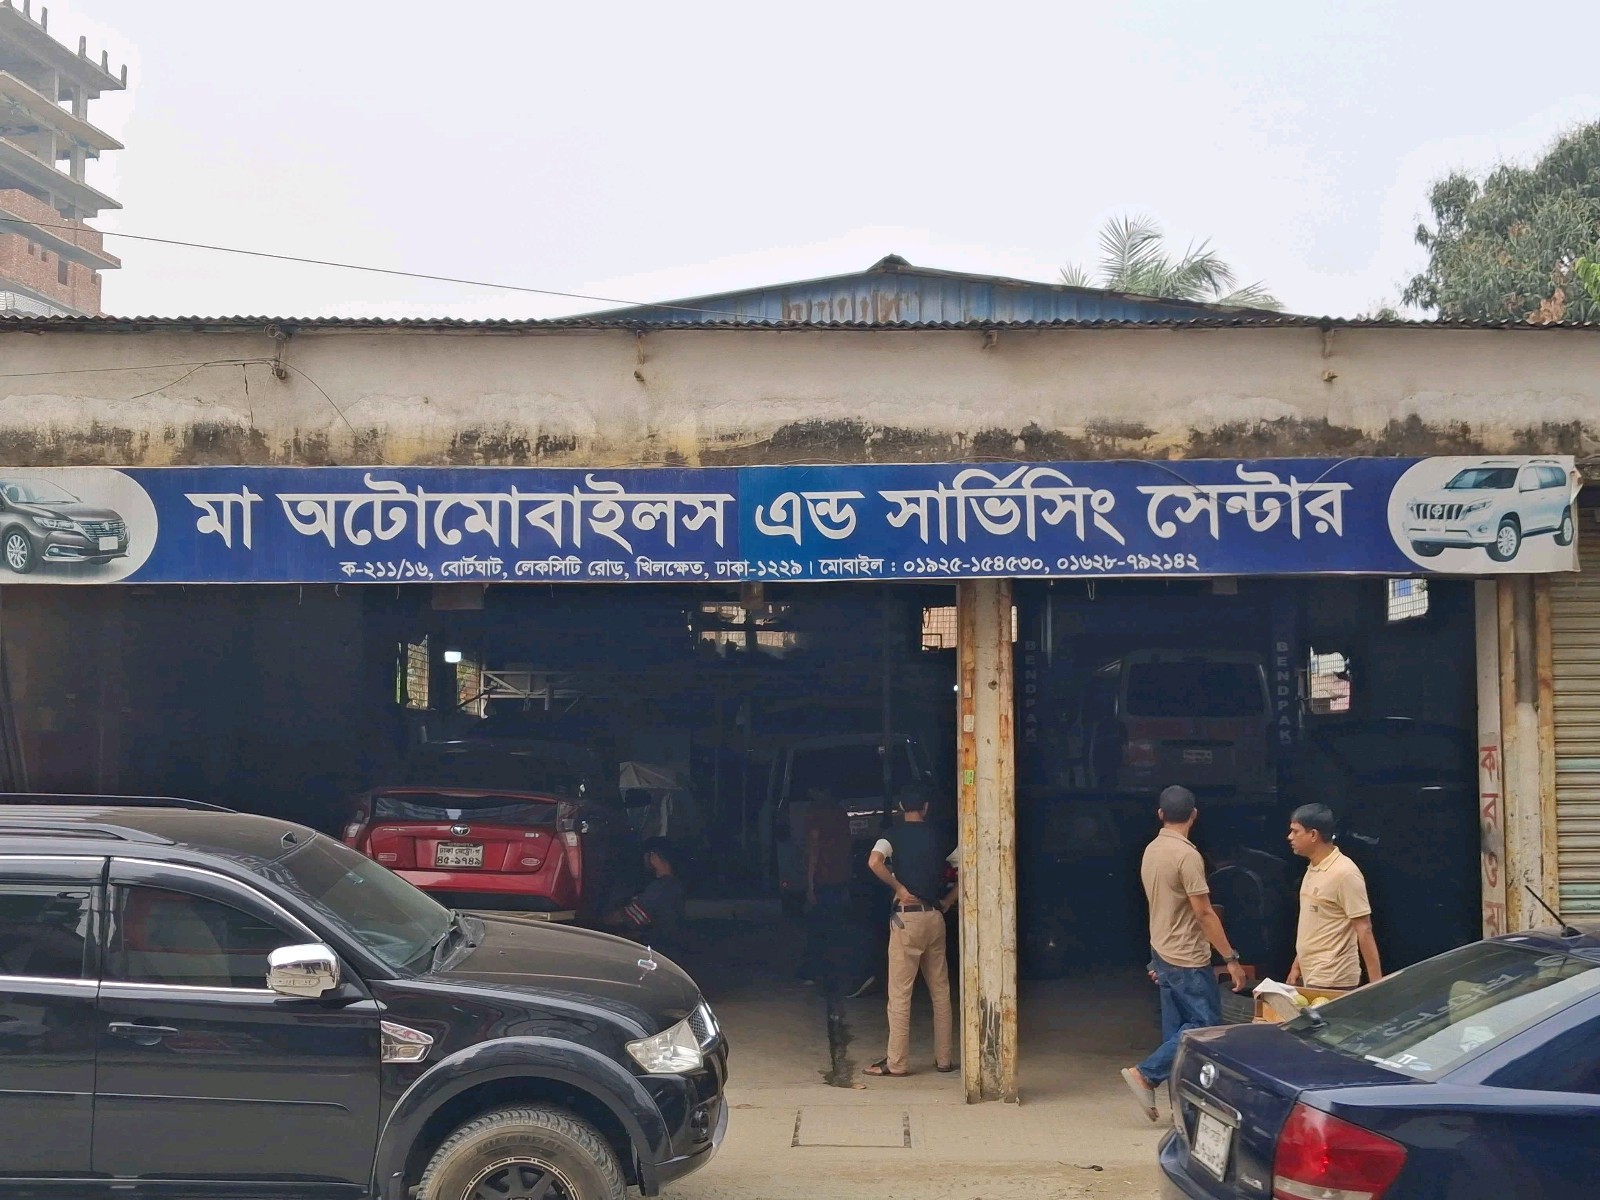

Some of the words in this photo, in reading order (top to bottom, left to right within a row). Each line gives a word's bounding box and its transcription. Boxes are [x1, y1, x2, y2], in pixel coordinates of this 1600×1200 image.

[183, 484, 264, 550] মা
[275, 472, 736, 555] অটোমোবাইলস
[755, 491, 865, 546] এন্ড
[878, 465, 1125, 546] সার্ভিসিং
[1136, 463, 1354, 541] সেন্টার
[339, 558, 434, 581] ক-২১১/১৬,
[515, 555, 583, 577] লেকসিটি
[588, 558, 630, 580] রোড,
[635, 555, 709, 580] খিলক্ষেত,
[714, 559, 803, 577] ঢাকা-১২২৯
[818, 553, 885, 576] মোবাইল
[1056, 552, 1200, 573] ০১৬২৮-৭৯২১৪২
[1276, 641, 1291, 741] BENDPAK
